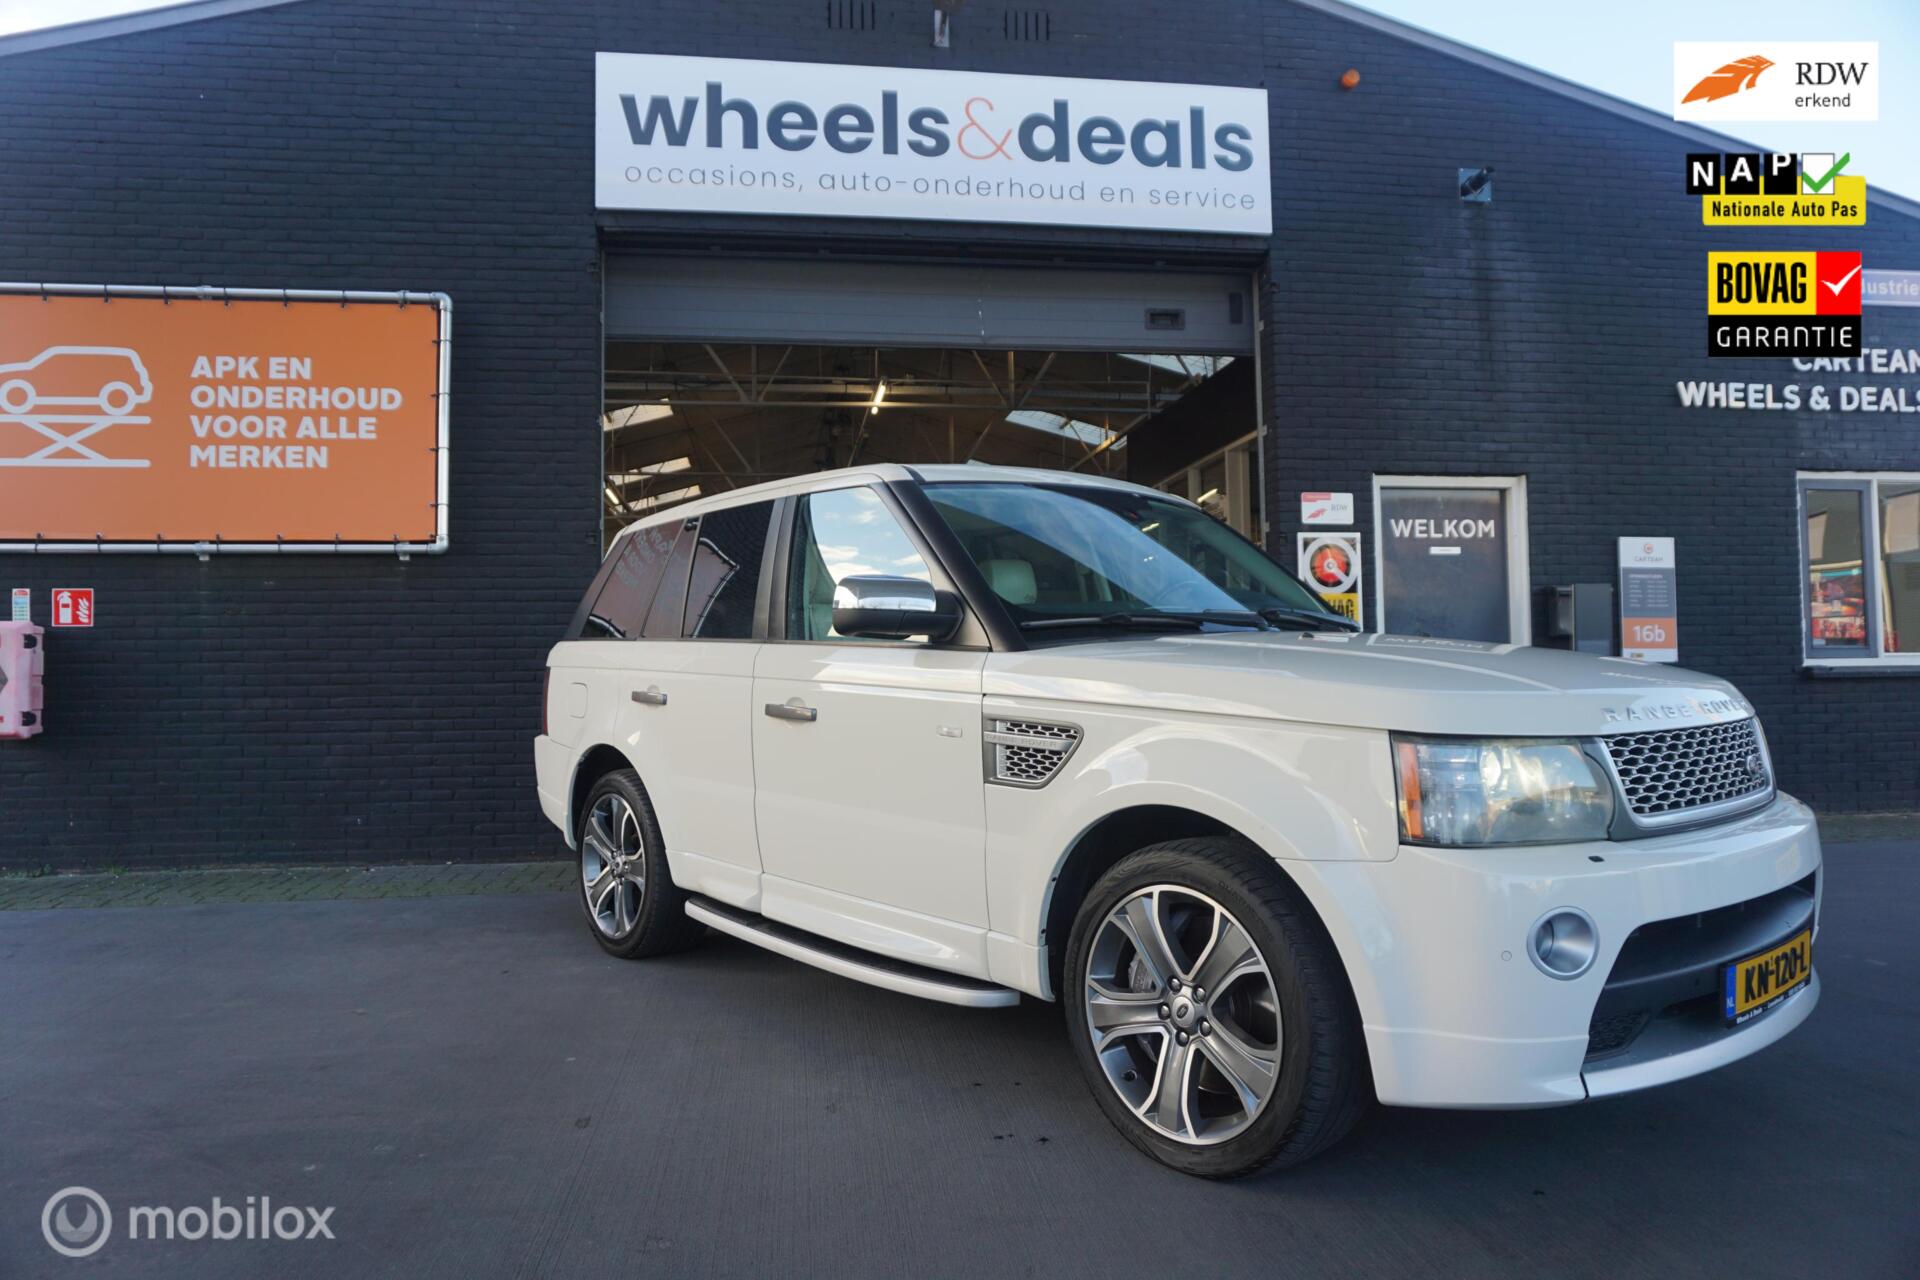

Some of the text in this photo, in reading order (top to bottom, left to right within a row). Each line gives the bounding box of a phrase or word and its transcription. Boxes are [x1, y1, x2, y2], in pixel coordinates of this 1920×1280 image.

[619, 80, 1254, 172] wheels&deals
[624, 163, 1256, 211] occasions, auto-onderhoud en service
[190, 355, 312, 379] APK EN
[190, 385, 402, 410] ONDERHOUD
[1676, 380, 1920, 413] WHEELS & DEAL
[190, 415, 377, 439] VOOR ALLE
[190, 446, 328, 468] MERKEN
[1389, 518, 1496, 539] WELKOM
[1632, 624, 1666, 643] 16b
[1601, 697, 1748, 722] RANGE ROVER
